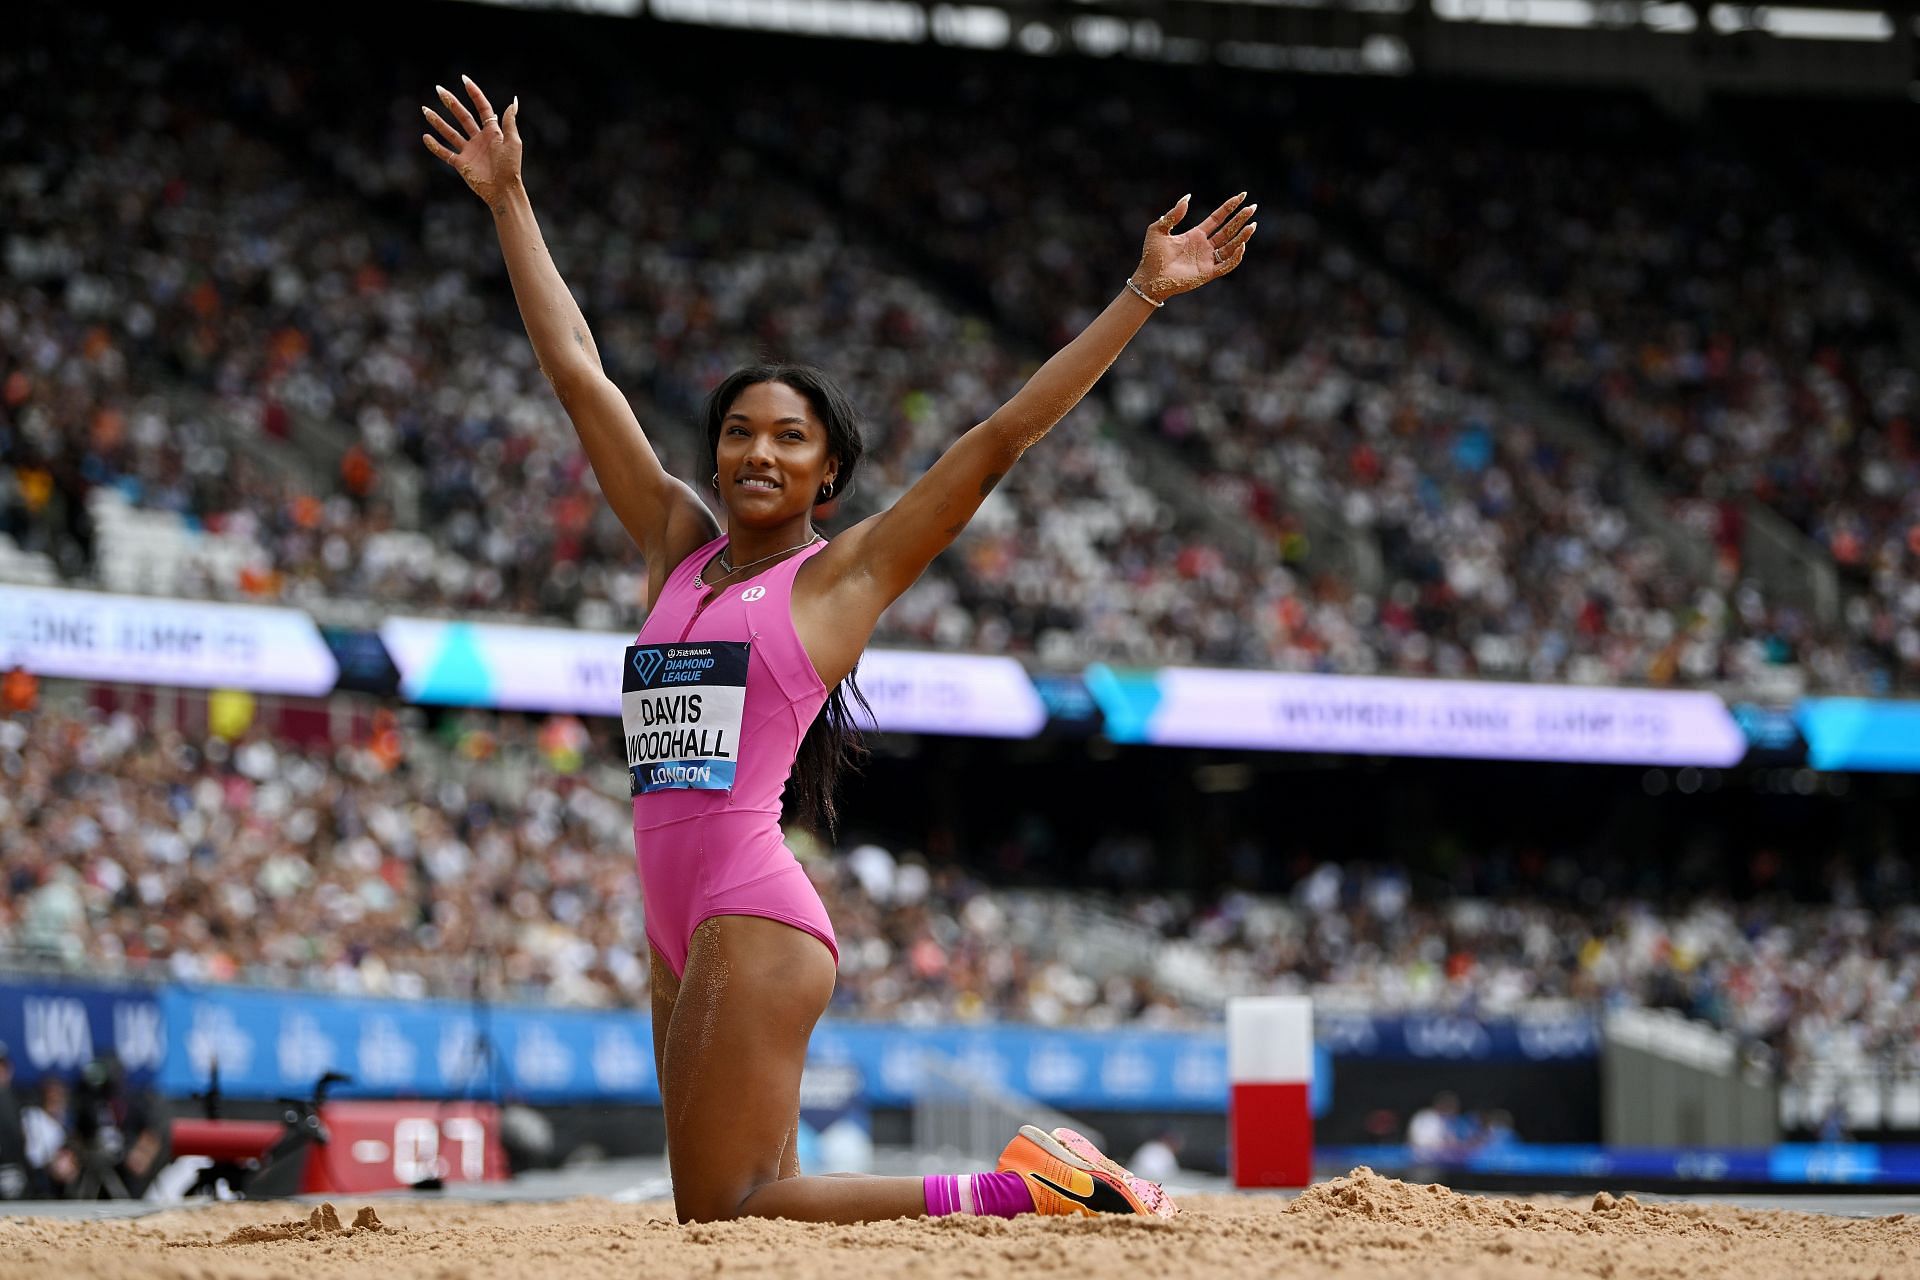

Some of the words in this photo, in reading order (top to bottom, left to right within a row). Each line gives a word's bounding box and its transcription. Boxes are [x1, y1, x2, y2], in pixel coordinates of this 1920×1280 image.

[689, 648, 712, 656] WANDA
[665, 658, 715, 671] DIAMOND
[661, 670, 703, 683] LEAGUE
[641, 694, 703, 727] DAVIS
[627, 729, 730, 764] WOODHALL
[650, 766, 711, 785] LONDON
